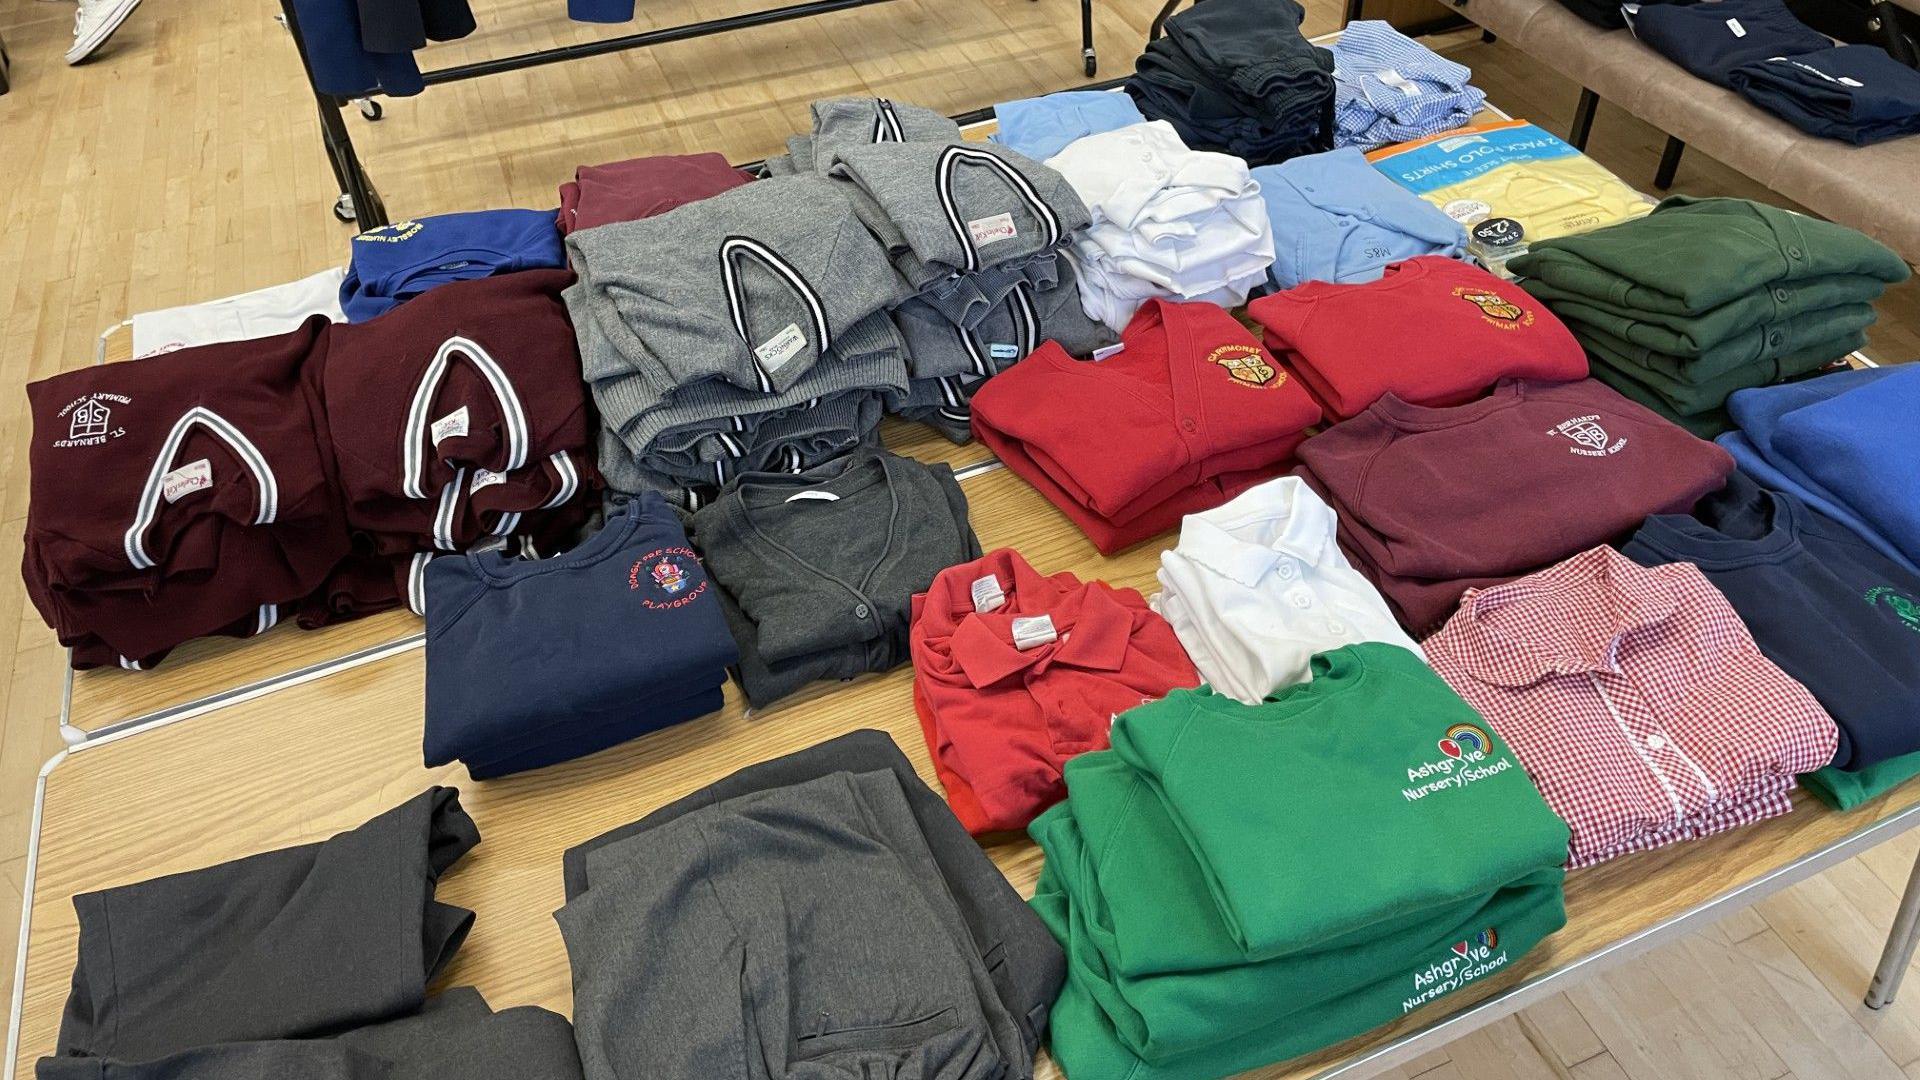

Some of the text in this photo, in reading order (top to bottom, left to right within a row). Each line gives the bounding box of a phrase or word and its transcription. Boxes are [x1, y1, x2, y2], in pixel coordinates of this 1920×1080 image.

[1508, 140, 1546, 152] PACK
[1548, 137, 1559, 145] 2
[1402, 160, 1458, 182] SHIRTS
[1493, 234, 1514, 245] PACK
[1363, 247, 1392, 258] M&S
[57, 392, 132, 418] PRIMARY SCHOOL
[665, 547, 703, 565] SCHO
[642, 580, 708, 610] PLAYGROUP
[1401, 757, 1513, 802] Nursery School
[1402, 977, 1459, 1013] Nursery
